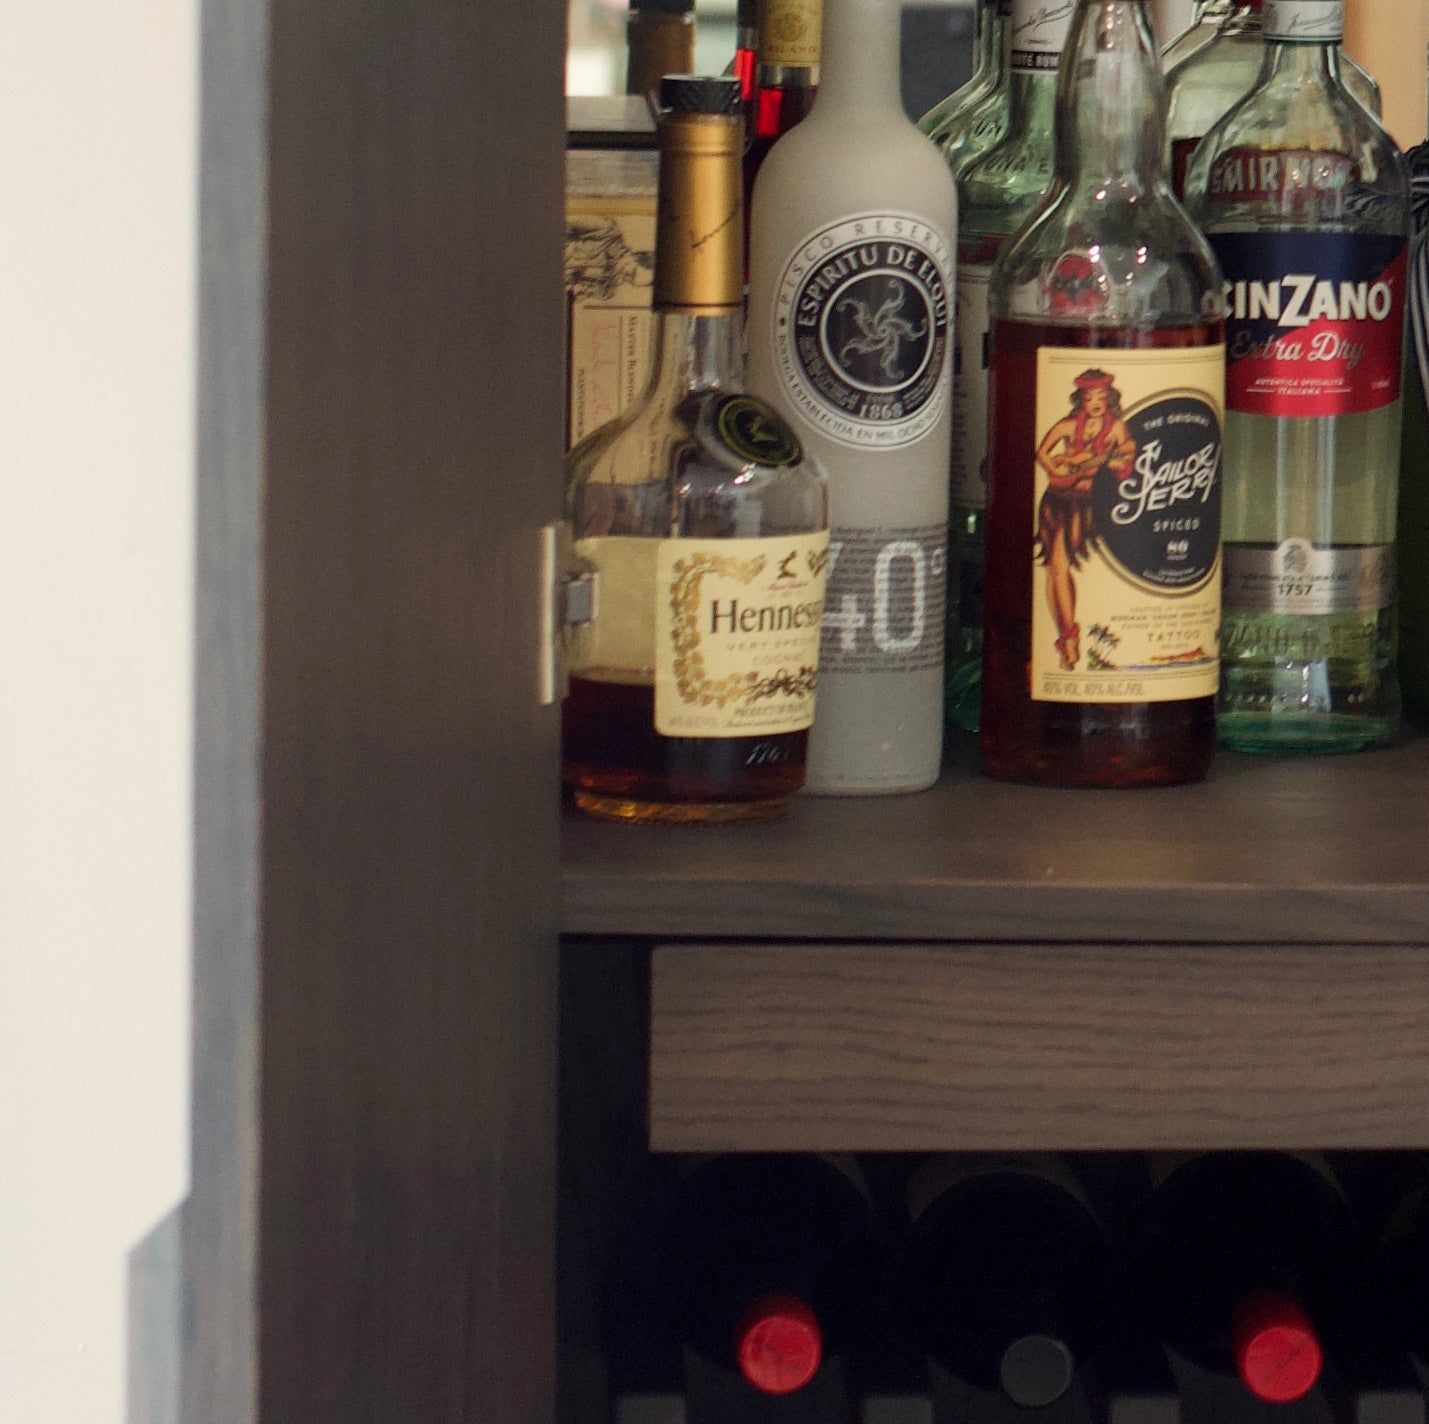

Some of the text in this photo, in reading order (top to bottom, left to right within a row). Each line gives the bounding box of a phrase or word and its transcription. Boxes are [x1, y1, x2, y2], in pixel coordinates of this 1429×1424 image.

[798, 244, 879, 326] ESPIRITU
[885, 245, 919, 270] DE
[1219, 274, 1392, 327] CINZANO
[1230, 329, 1365, 370] Extra Dry
[1118, 439, 1216, 501] SAILOR
[1152, 518, 1200, 533] SPICED
[1277, 583, 1314, 597] 1757
[1146, 630, 1201, 643] TATTOO
